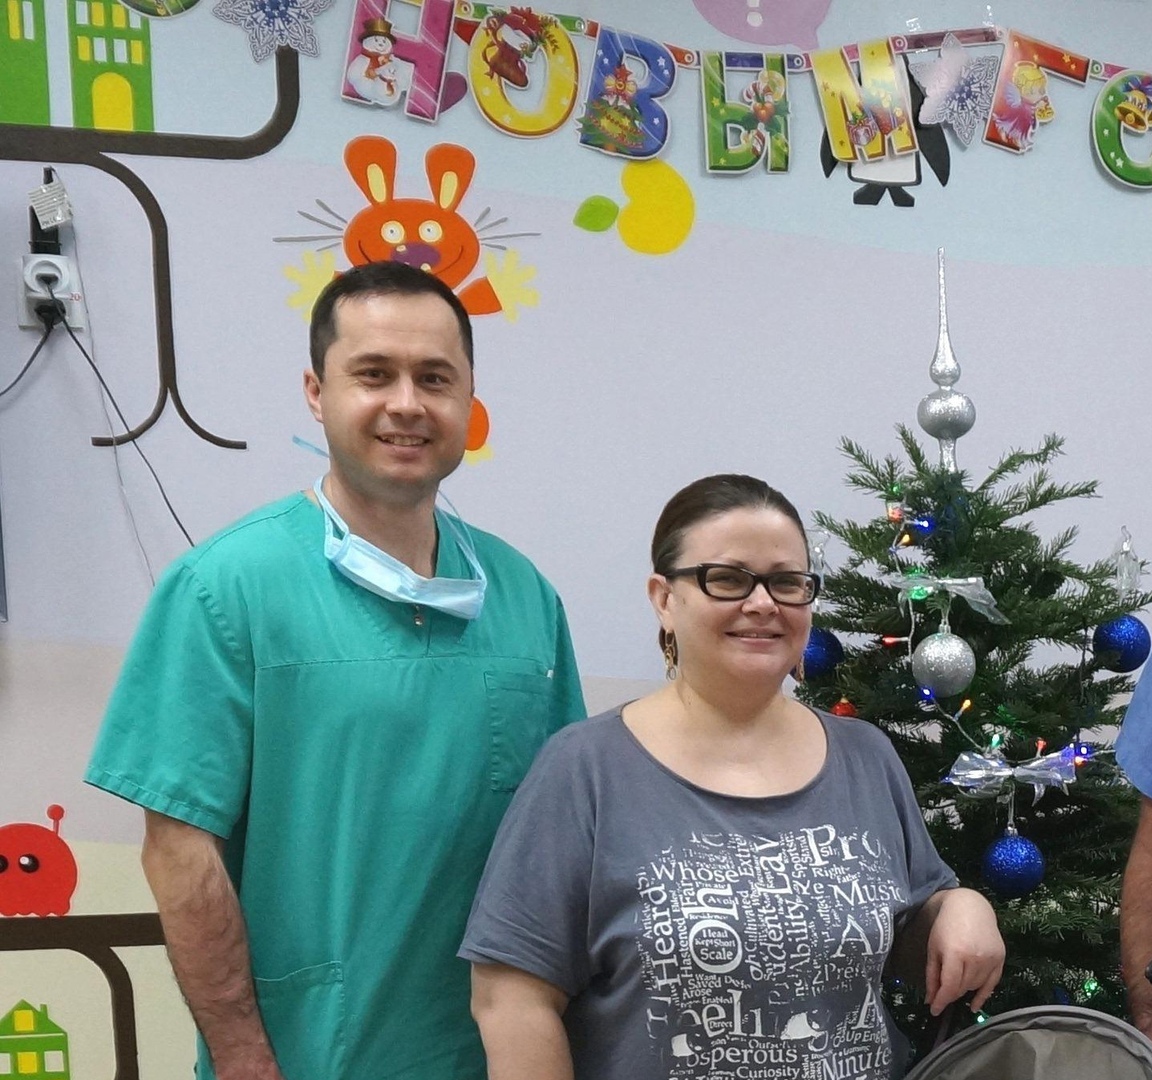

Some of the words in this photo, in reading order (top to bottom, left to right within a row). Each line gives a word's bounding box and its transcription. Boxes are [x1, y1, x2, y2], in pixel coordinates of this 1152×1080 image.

[341, 0, 919, 174] НОВЫМ
[651, 861, 740, 883] Whose
[736, 890, 758, 952] Cultivated
[640, 883, 681, 991] Heard
[672, 917, 693, 978] Hastened
[700, 947, 733, 961] Scale
[683, 987, 712, 1000] Arose
[688, 977, 722, 990] Saved
[736, 1065, 800, 1080] Curiosity
